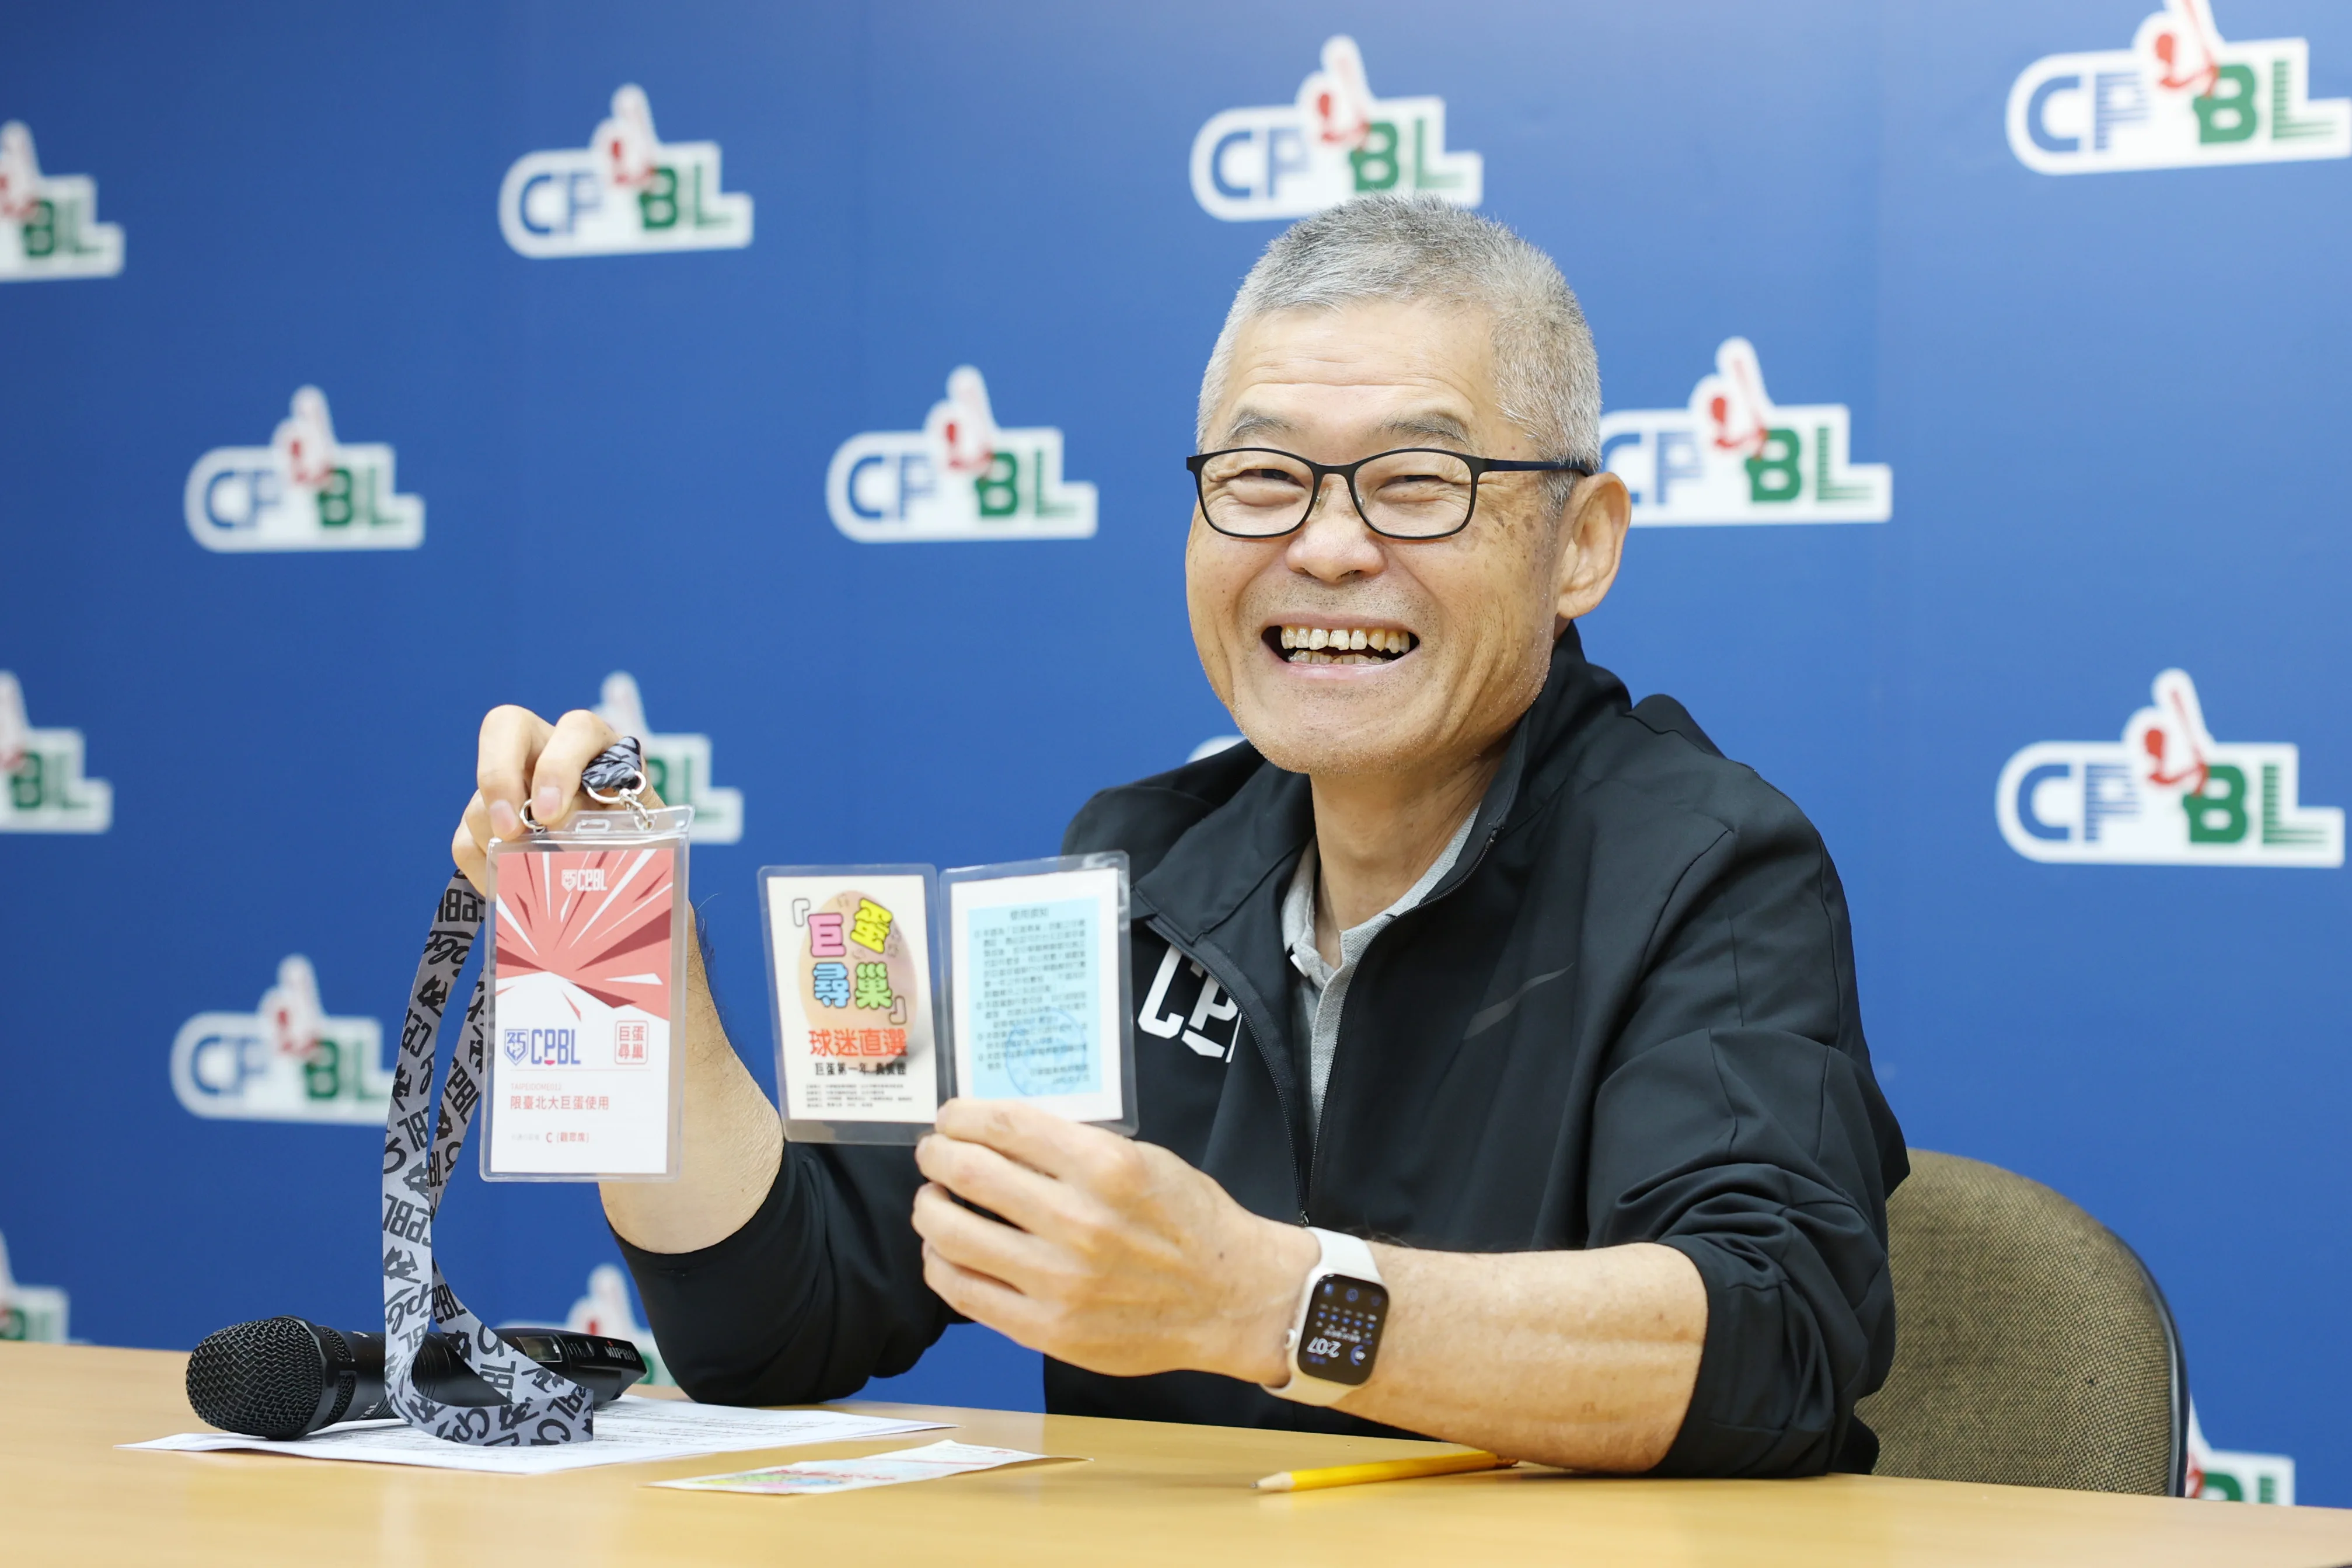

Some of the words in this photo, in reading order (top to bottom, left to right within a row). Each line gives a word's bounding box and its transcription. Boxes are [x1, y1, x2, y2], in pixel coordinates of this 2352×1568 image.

[2025, 57, 2337, 155] CPBL
[1211, 117, 1465, 197] CPBL
[519, 163, 735, 236] CPBL
[203, 465, 406, 529] CPBL
[846, 447, 1080, 519] CPBL
[2016, 763, 2330, 844] CPBL
[577, 869, 608, 891] CPBL
[1138, 944, 1243, 1063] CP
[531, 1029, 581, 1065] CPBL
[809, 1028, 908, 1057] 球迷直選
[510, 1095, 609, 1110] 限臺北大巨蛋使用
[546, 1132, 553, 1143] C
[604, 1346, 637, 1361] MIPRO
[1307, 1336, 1342, 1358] 2:07
